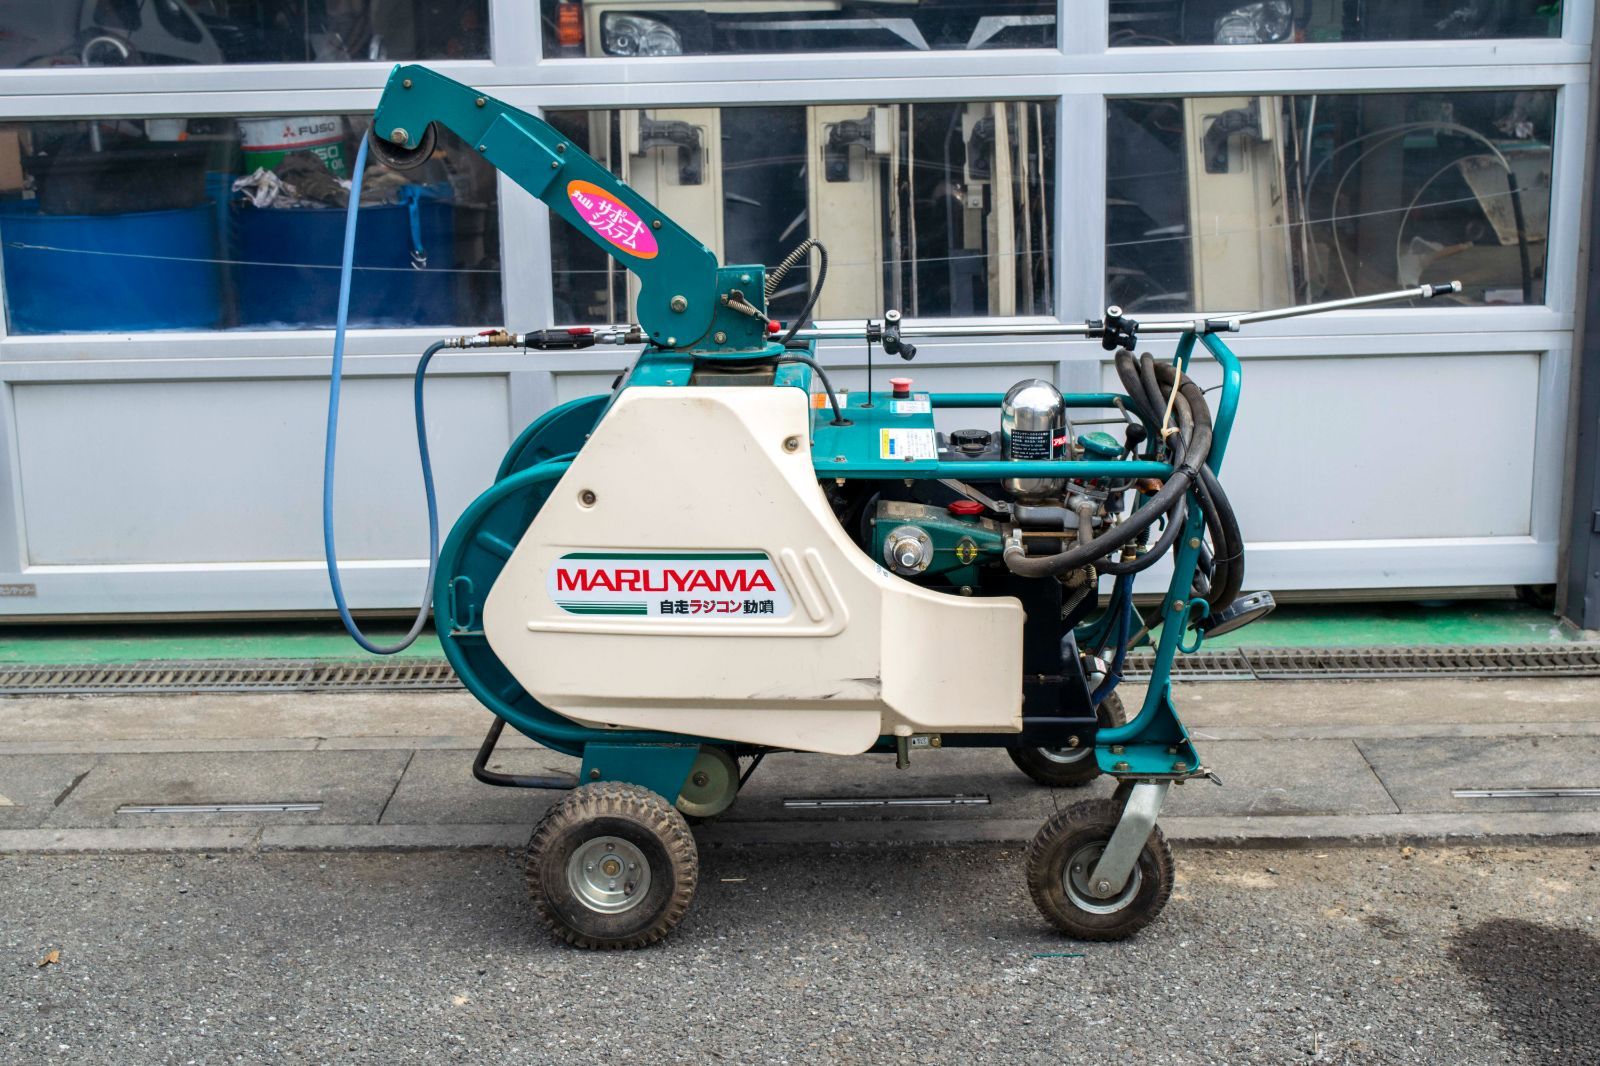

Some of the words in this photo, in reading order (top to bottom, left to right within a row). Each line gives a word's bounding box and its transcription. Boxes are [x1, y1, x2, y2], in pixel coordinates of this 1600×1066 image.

[298, 122, 336, 136] FUSO
[598, 200, 645, 234] サポート
[588, 212, 637, 249] システム
[556, 568, 777, 592] MARUYAMA
[660, 599, 775, 615] 自走ラジコン動噴
